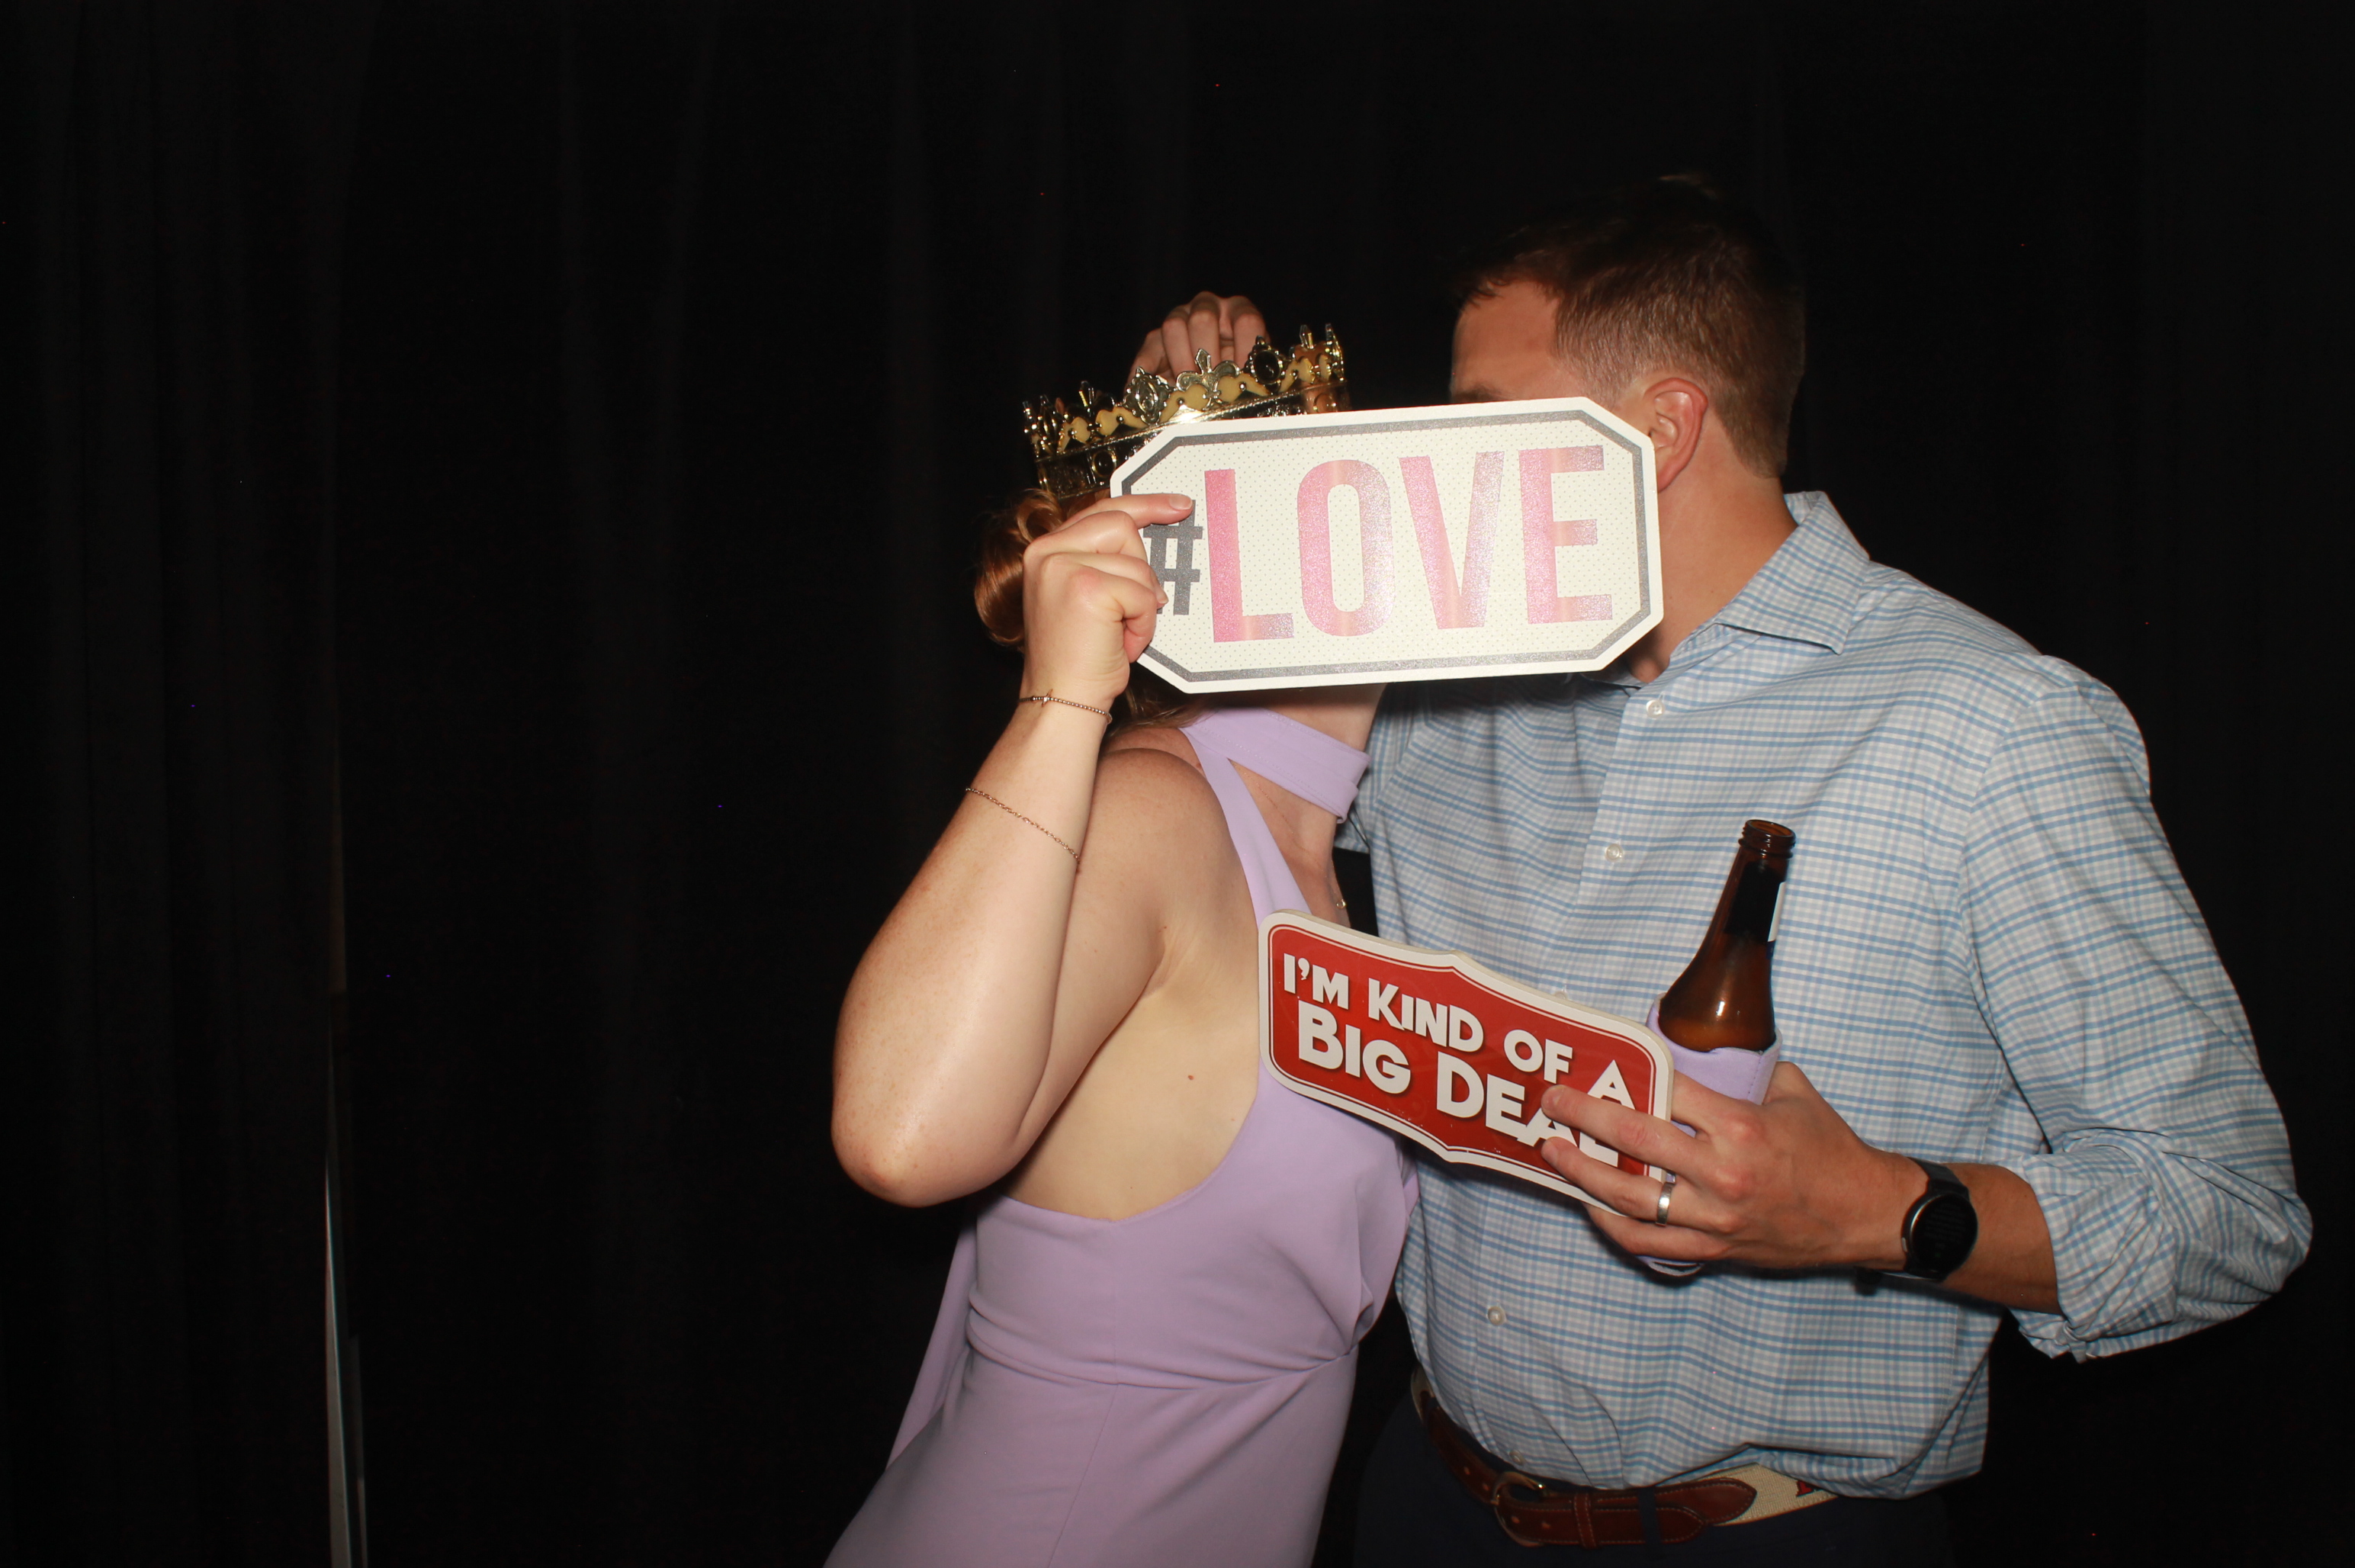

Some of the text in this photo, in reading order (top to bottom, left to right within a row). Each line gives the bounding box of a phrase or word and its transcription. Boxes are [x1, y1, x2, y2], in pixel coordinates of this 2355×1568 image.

[1143, 445, 1613, 642] #LOVE
[1284, 953, 1636, 1110] I'M KIND OF A
[1298, 1000, 1412, 1094] BIG
